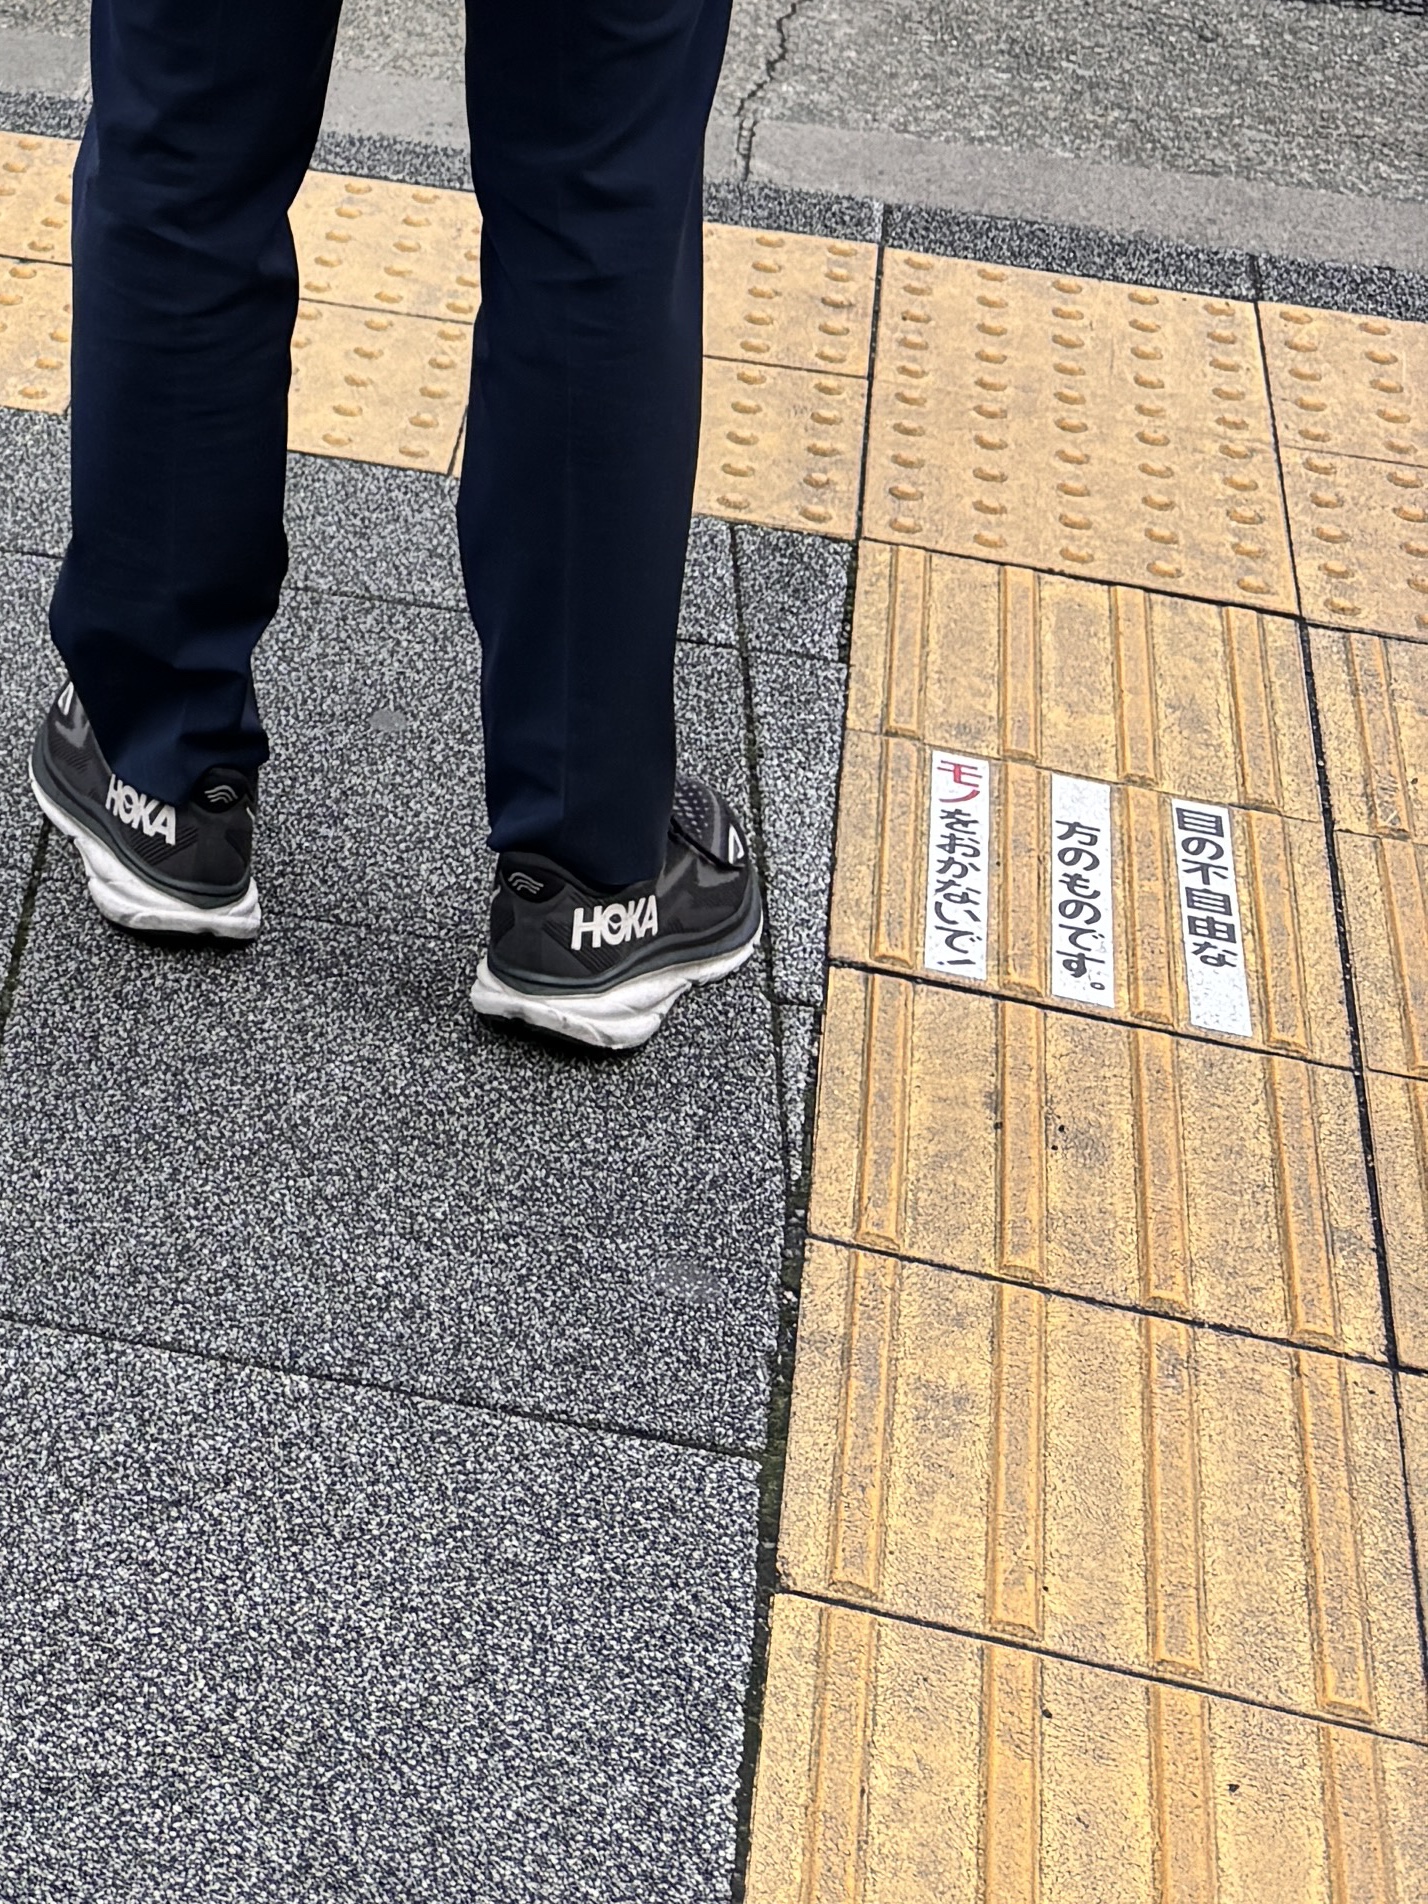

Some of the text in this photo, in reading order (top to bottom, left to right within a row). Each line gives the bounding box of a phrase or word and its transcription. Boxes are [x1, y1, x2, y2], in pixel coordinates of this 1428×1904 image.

[105, 774, 177, 846] HOKA
[571, 894, 660, 950] HOKA
[1055, 819, 1105, 991] 方のものです。
[1175, 807, 1237, 968] 目の不自由な
